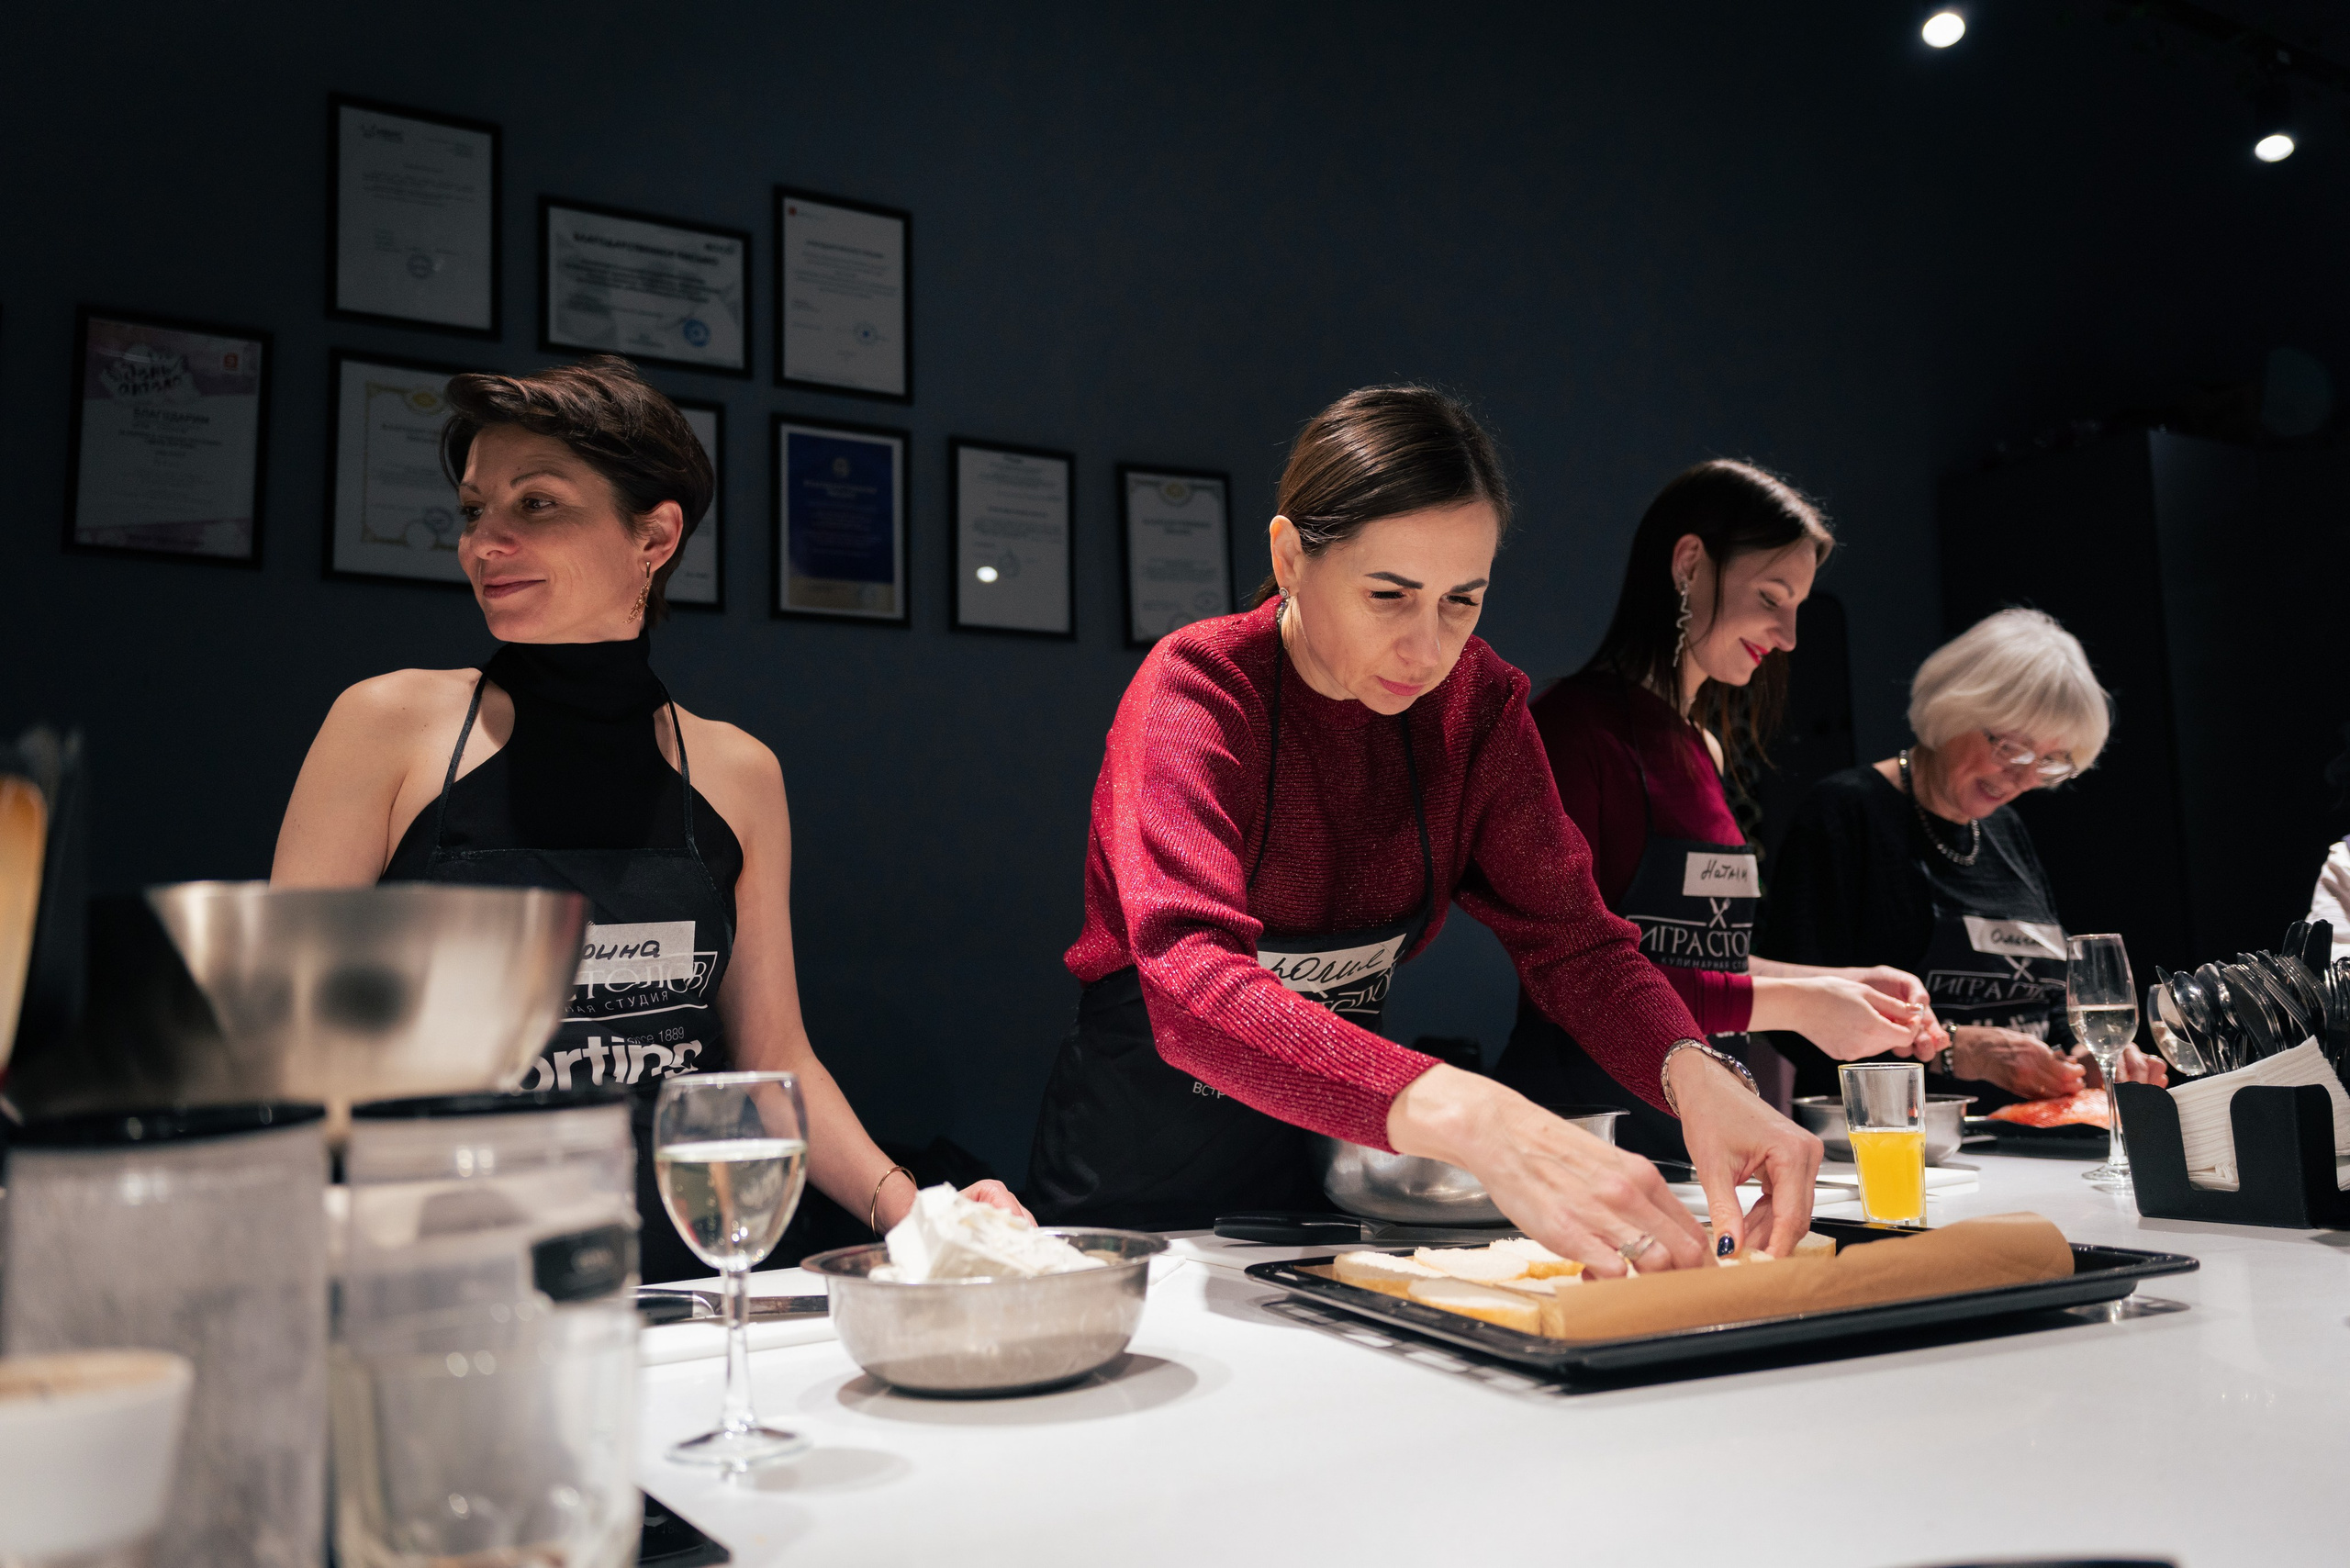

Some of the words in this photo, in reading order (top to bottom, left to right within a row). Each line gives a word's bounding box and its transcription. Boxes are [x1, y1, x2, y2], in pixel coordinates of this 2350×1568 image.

[1931, 975, 2003, 1001] ИГРА
[604, 991, 669, 1011] СТУДИЯ
[658, 1025, 685, 1043] 1889
